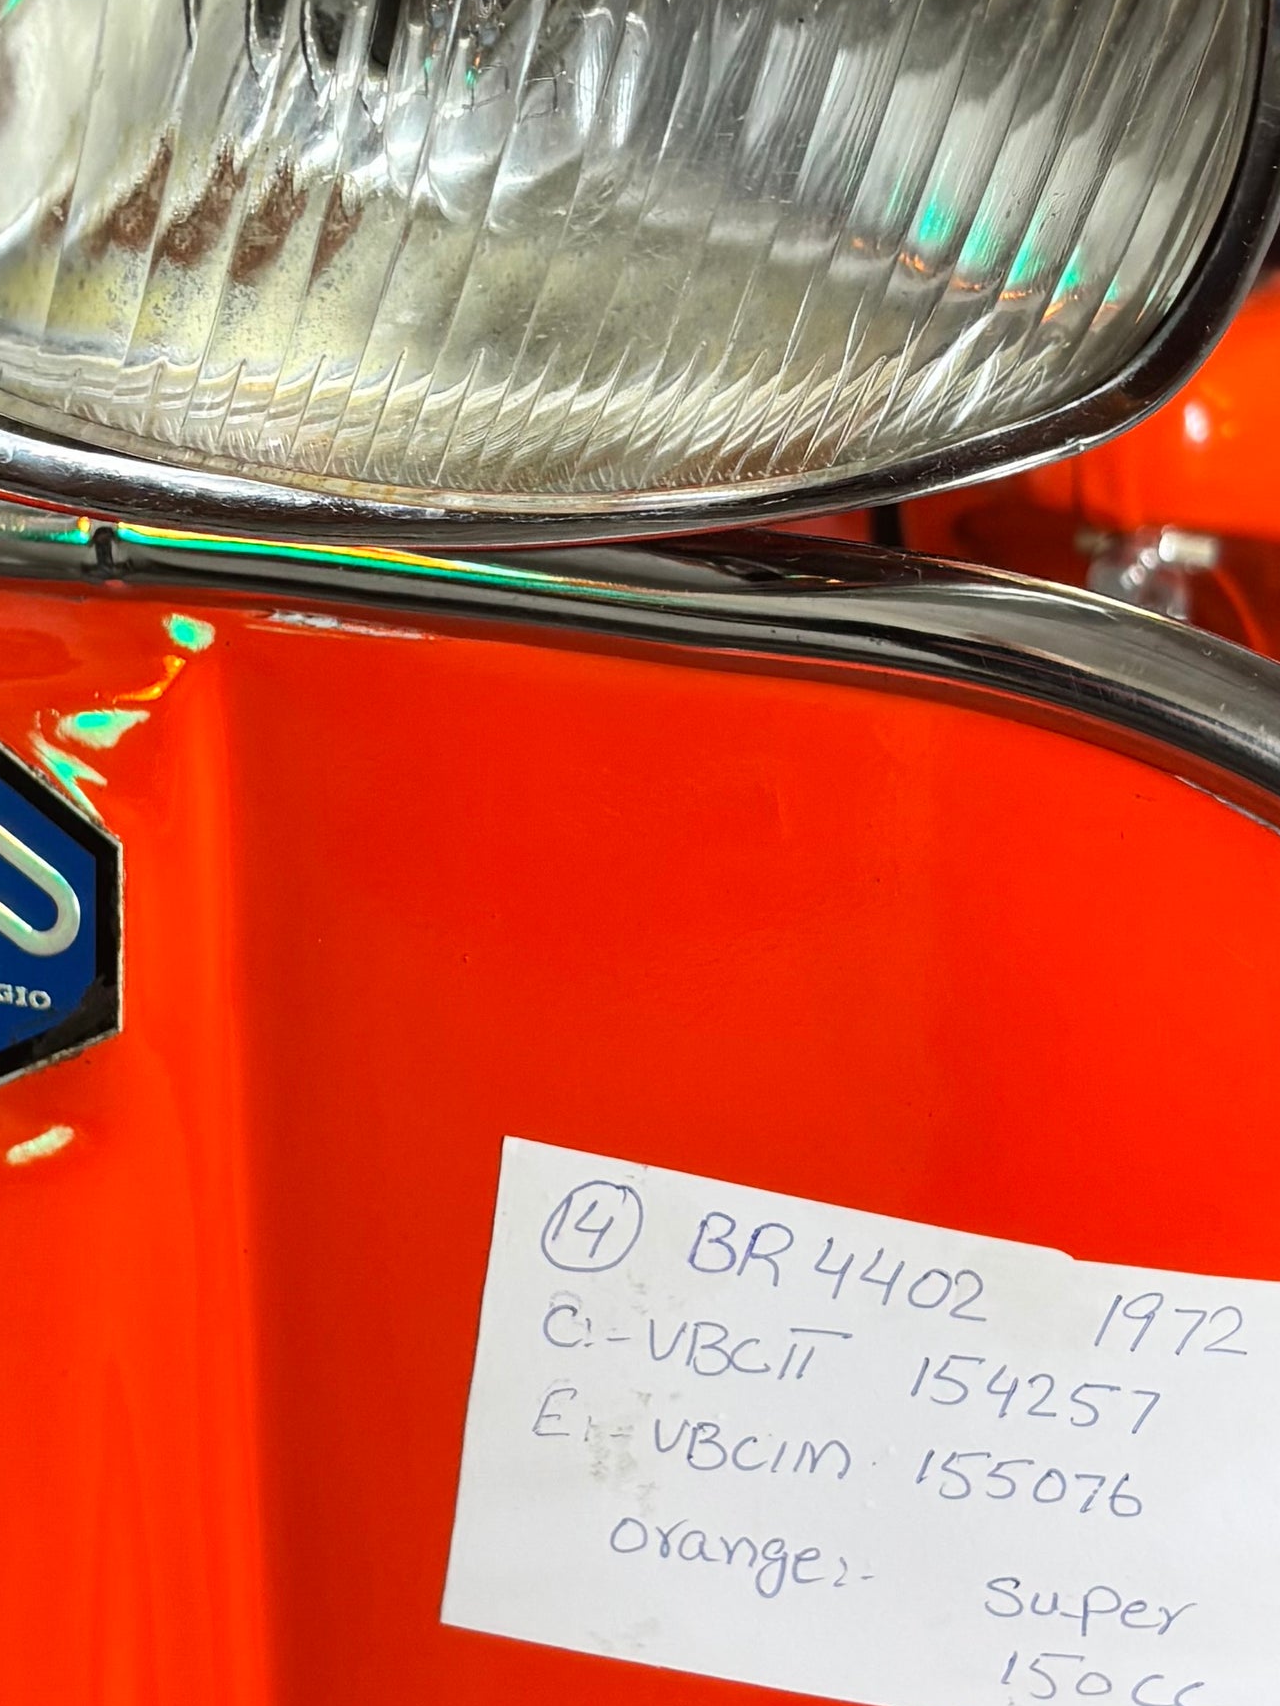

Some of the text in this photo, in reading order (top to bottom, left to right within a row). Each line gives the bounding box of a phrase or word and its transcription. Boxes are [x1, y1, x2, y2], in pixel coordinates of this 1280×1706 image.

[550, 1191, 618, 1261] 14
[1093, 1292, 1248, 1356] 1972
[909, 1354, 1161, 1435] 154257
[915, 1448, 1143, 1518] 155076
